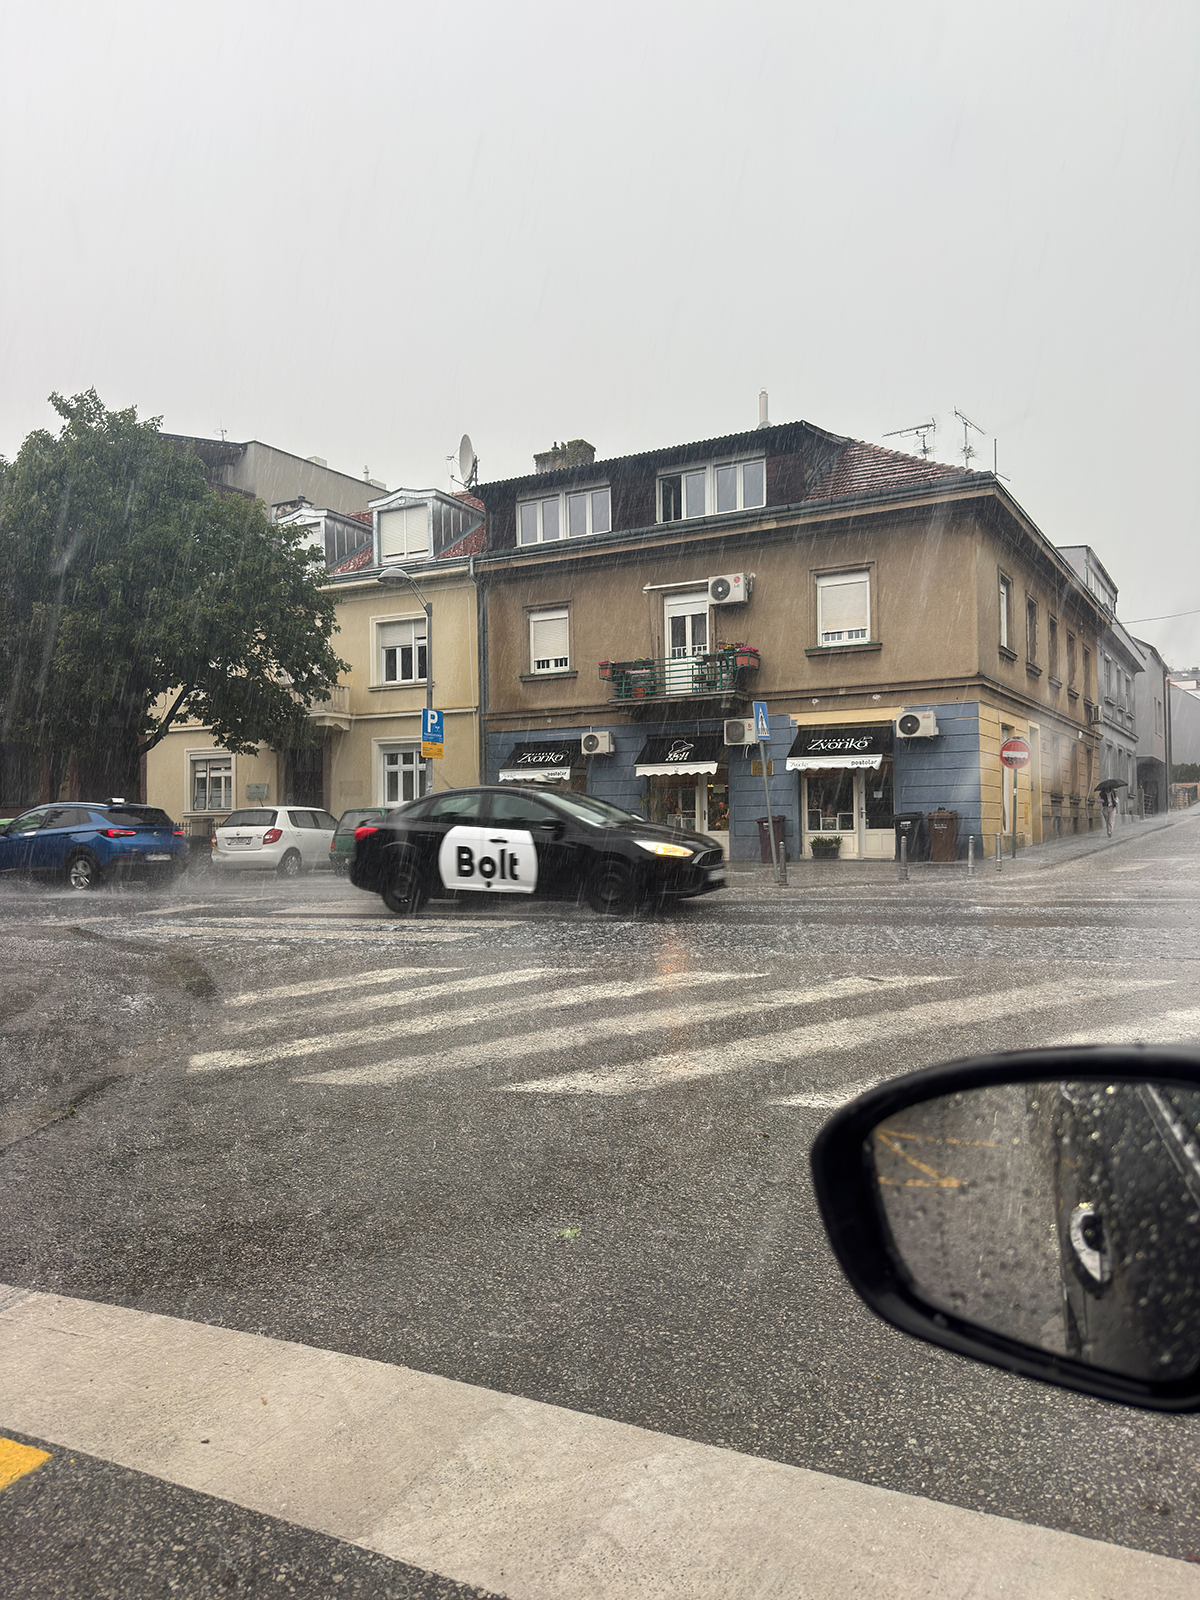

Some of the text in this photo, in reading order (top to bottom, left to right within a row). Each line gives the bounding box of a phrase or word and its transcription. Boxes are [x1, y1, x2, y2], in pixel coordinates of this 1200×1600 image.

[427, 710, 438, 733] P
[806, 737, 870, 751] Zvonko
[516, 752, 566, 764] Zvonko
[850, 758, 878, 766] postolar
[456, 846, 520, 881] Bolt
